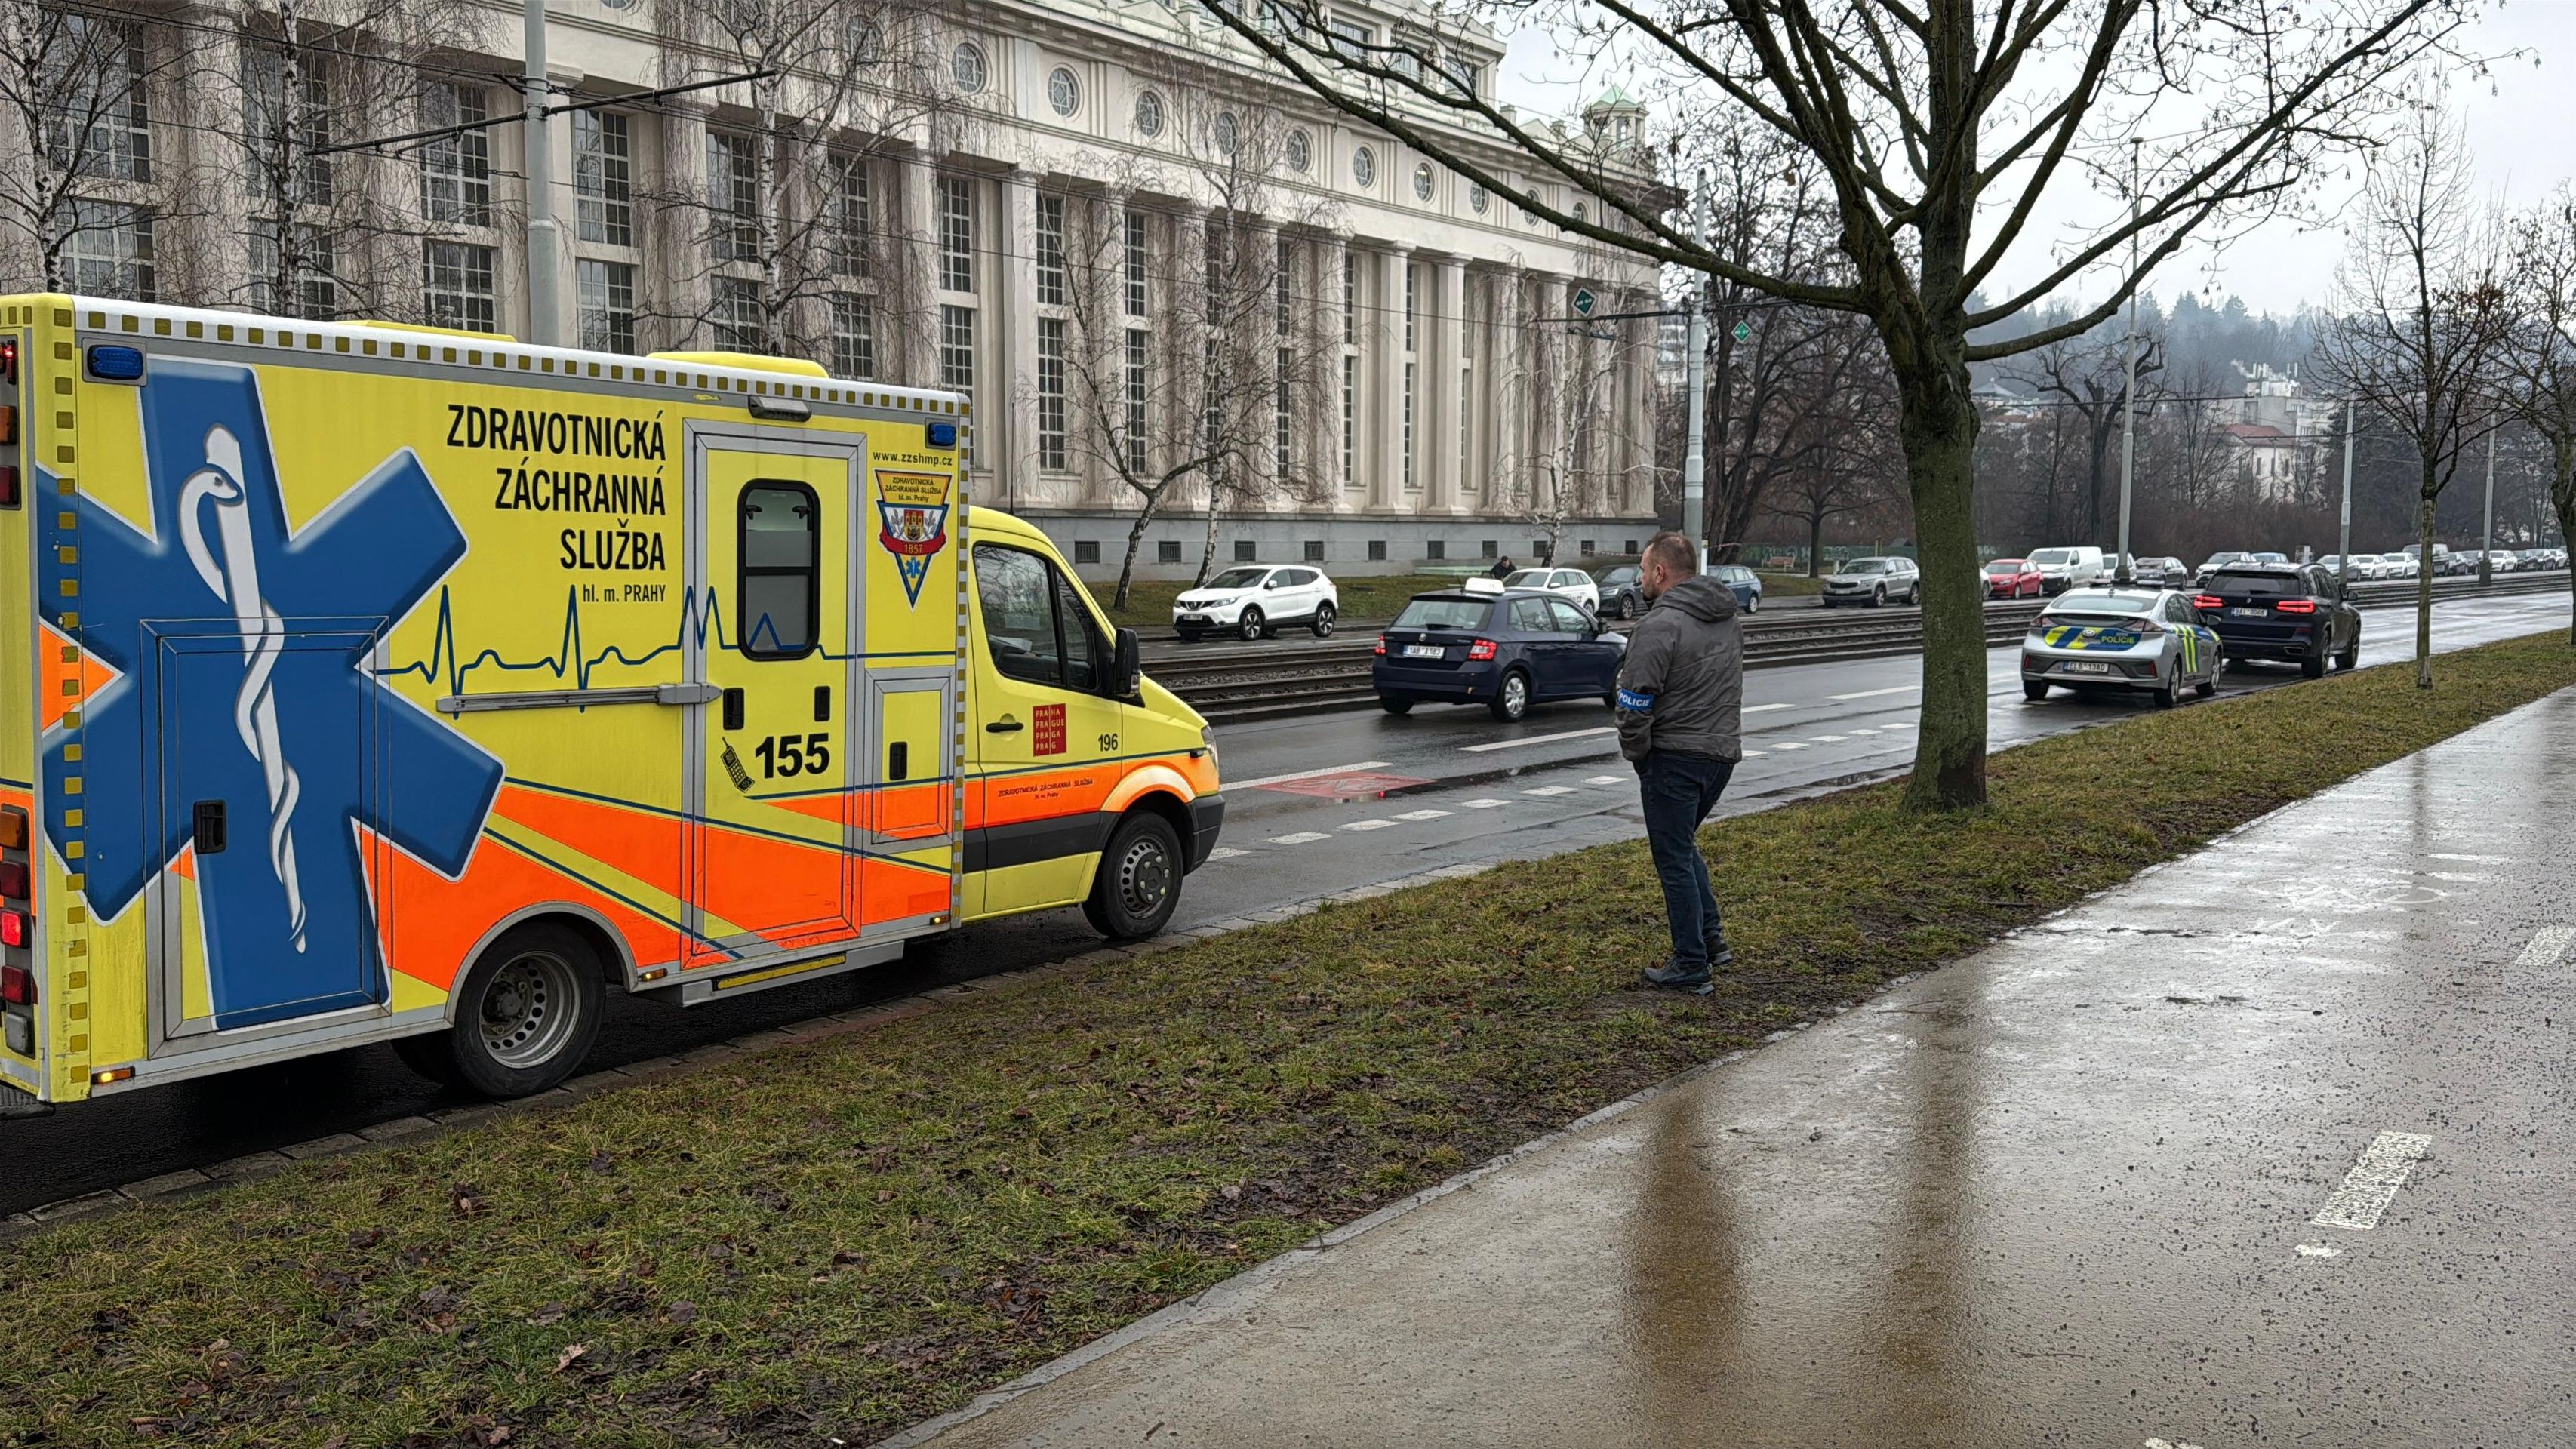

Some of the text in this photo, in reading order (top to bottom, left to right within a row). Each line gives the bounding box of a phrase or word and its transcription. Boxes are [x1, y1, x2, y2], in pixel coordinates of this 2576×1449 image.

[447, 405, 666, 461] ZDRAVOTNICKÁ
[873, 452, 953, 467] www.zzshmp.cz
[495, 457, 666, 515] ZÁCHRANNÁ
[560, 518, 666, 571] SLUŽBA
[904, 543, 923, 554] 1857
[583, 584, 666, 602] hl. m. PRAHY
[2101, 635, 2135, 644] POLICIE
[1619, 692, 1651, 707] POLICIE
[1097, 734, 1119, 752] 196
[756, 732, 830, 779] 155
